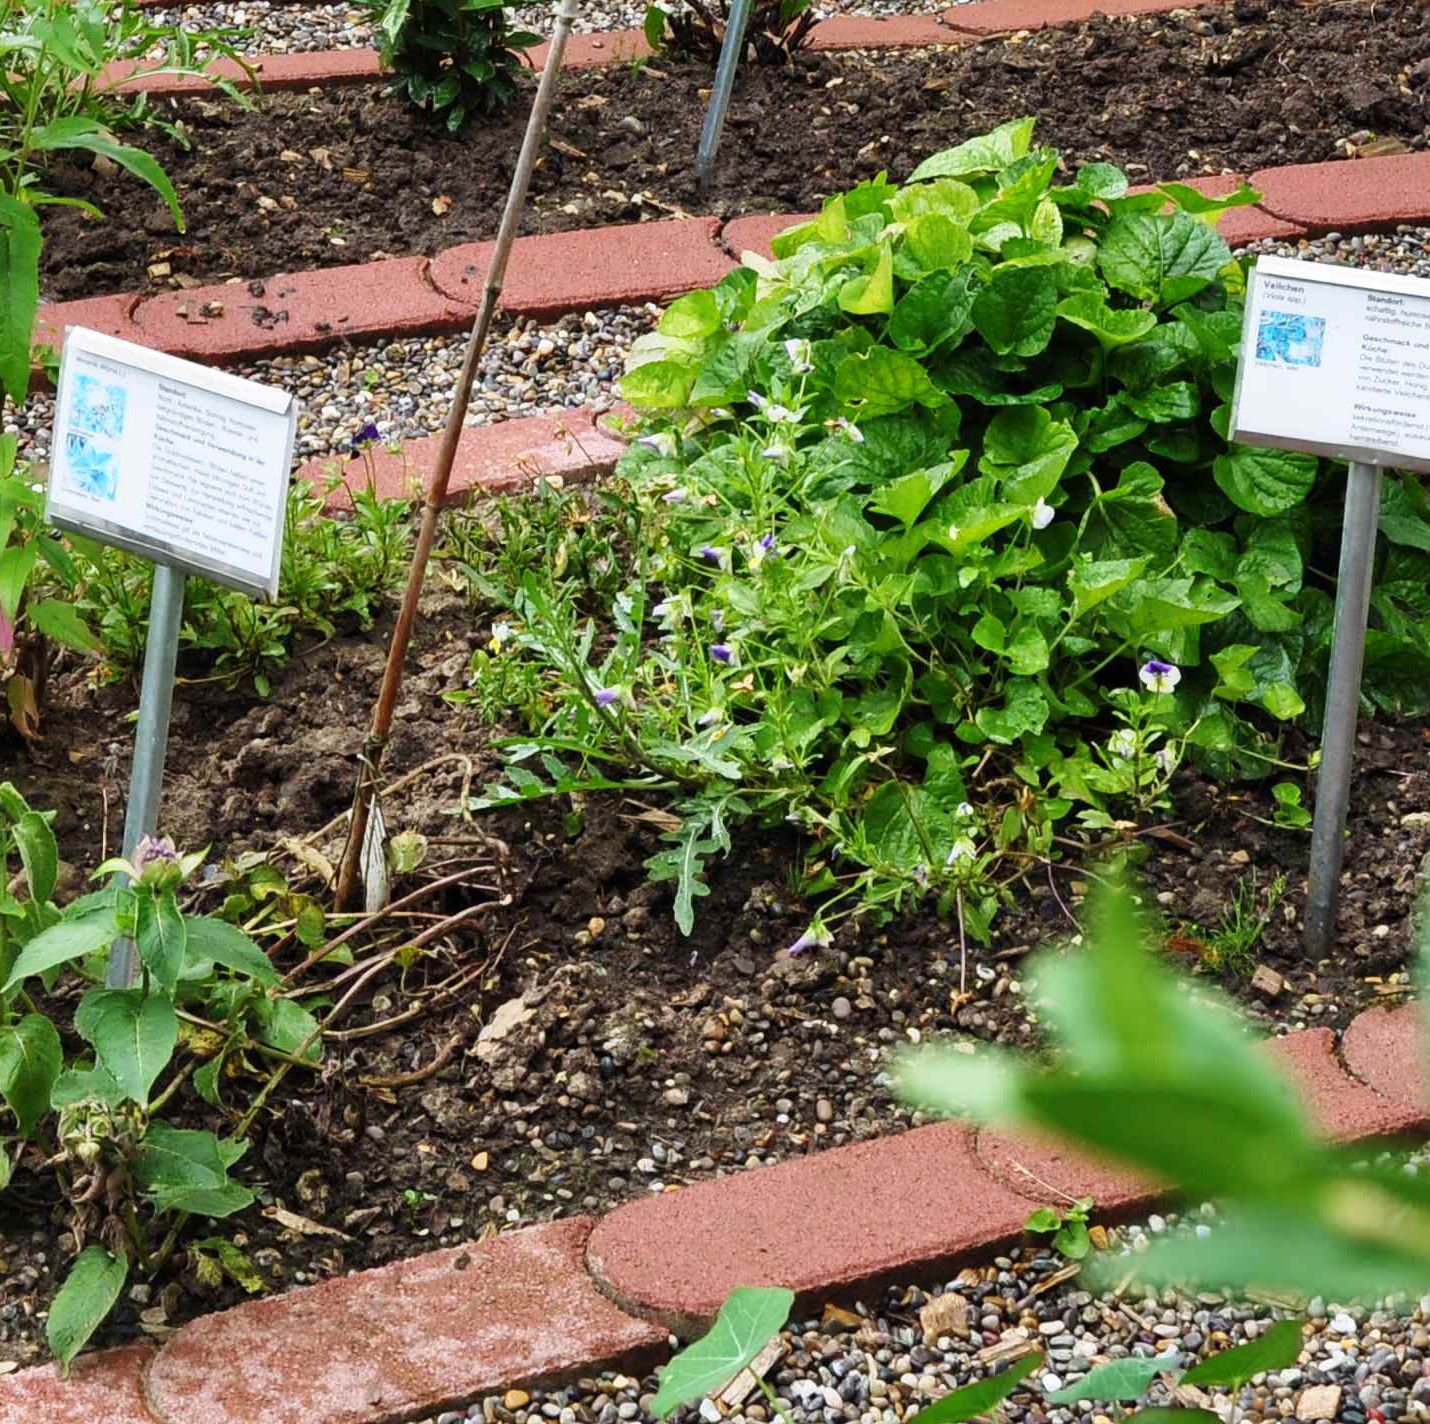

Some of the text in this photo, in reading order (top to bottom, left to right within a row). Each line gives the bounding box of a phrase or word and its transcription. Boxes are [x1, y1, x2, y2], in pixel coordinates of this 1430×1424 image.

[1262, 280, 1305, 293] Veilchen
[1366, 294, 1403, 305] Standort
[1362, 333, 1410, 346] Geschmack
